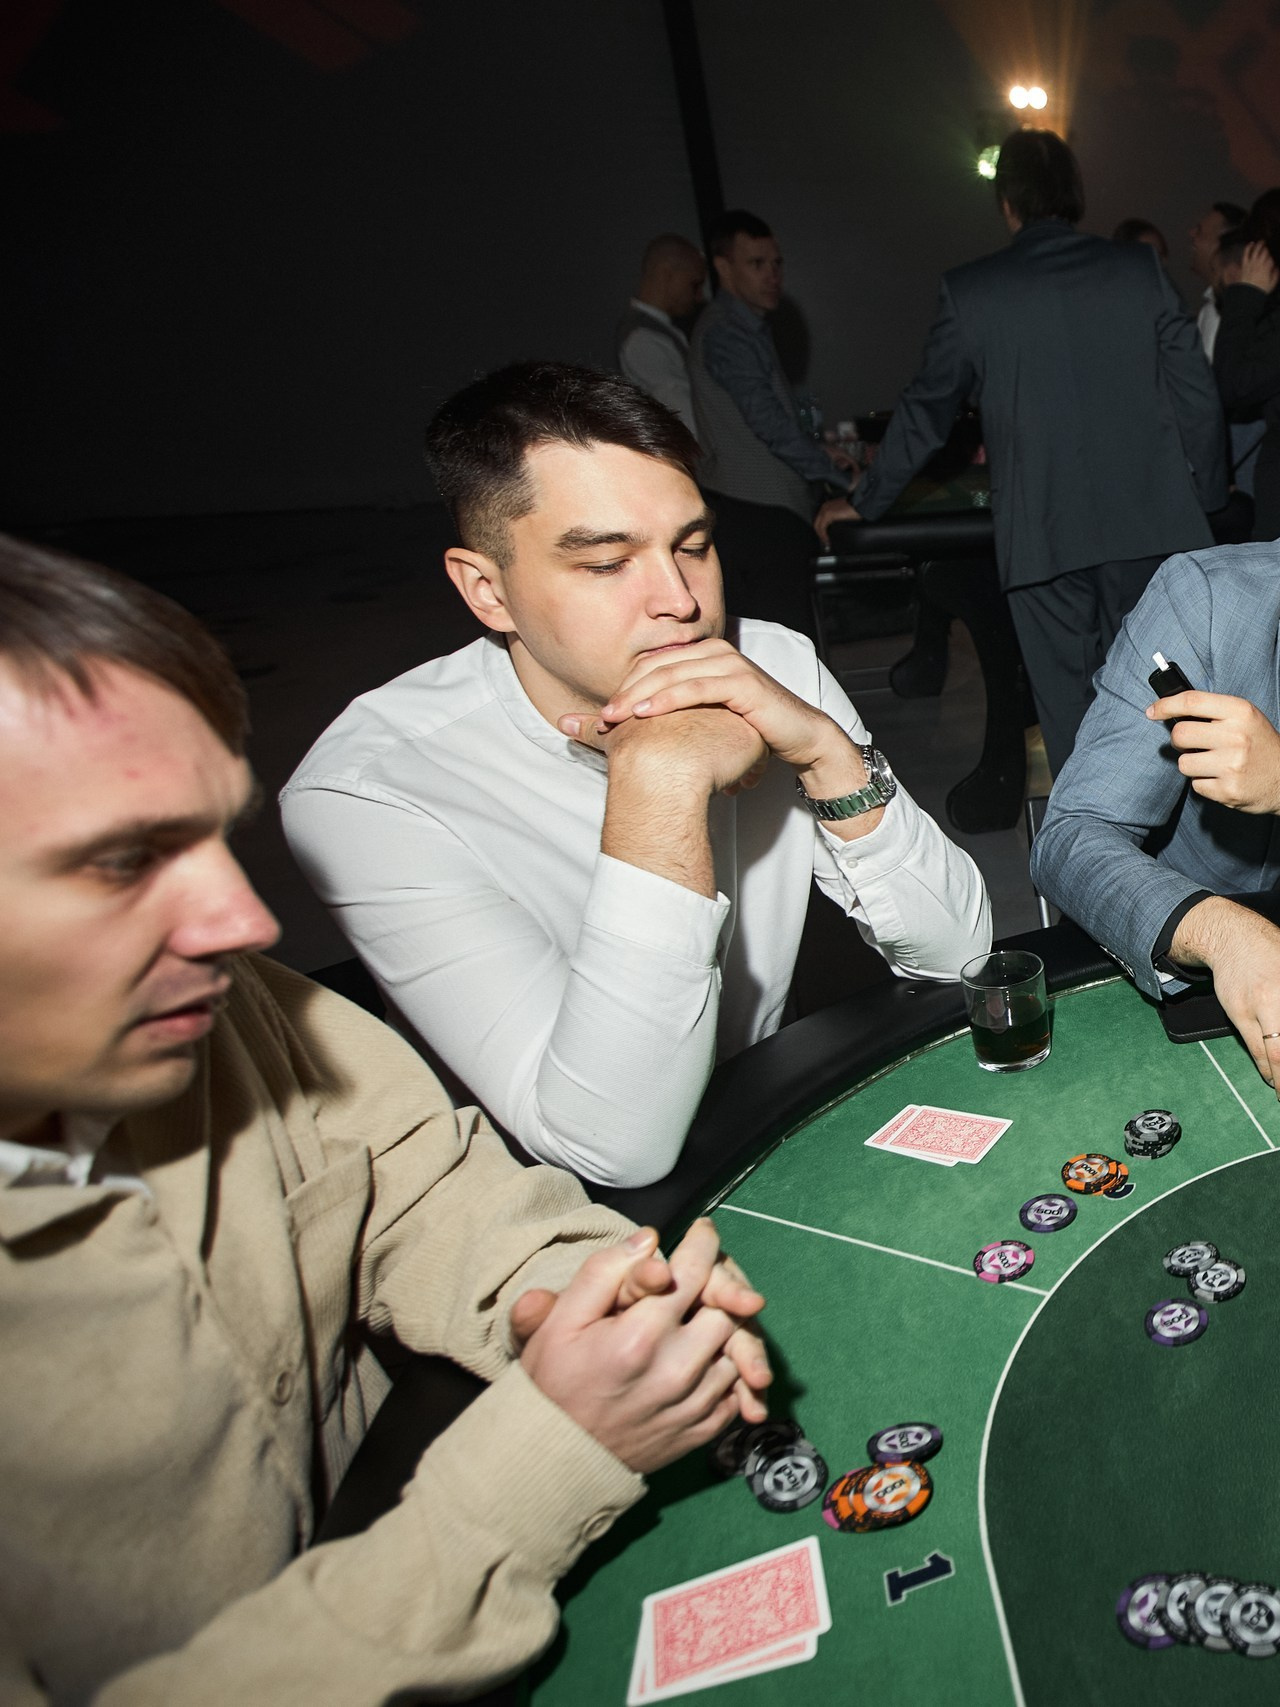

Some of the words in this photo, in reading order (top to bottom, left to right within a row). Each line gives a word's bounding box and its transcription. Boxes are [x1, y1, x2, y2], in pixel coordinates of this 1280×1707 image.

[1036, 1208, 1060, 1216] 500
[1164, 1313, 1189, 1327] 500
[876, 1479, 905, 1498] 1000
[884, 1549, 955, 1607] 1
